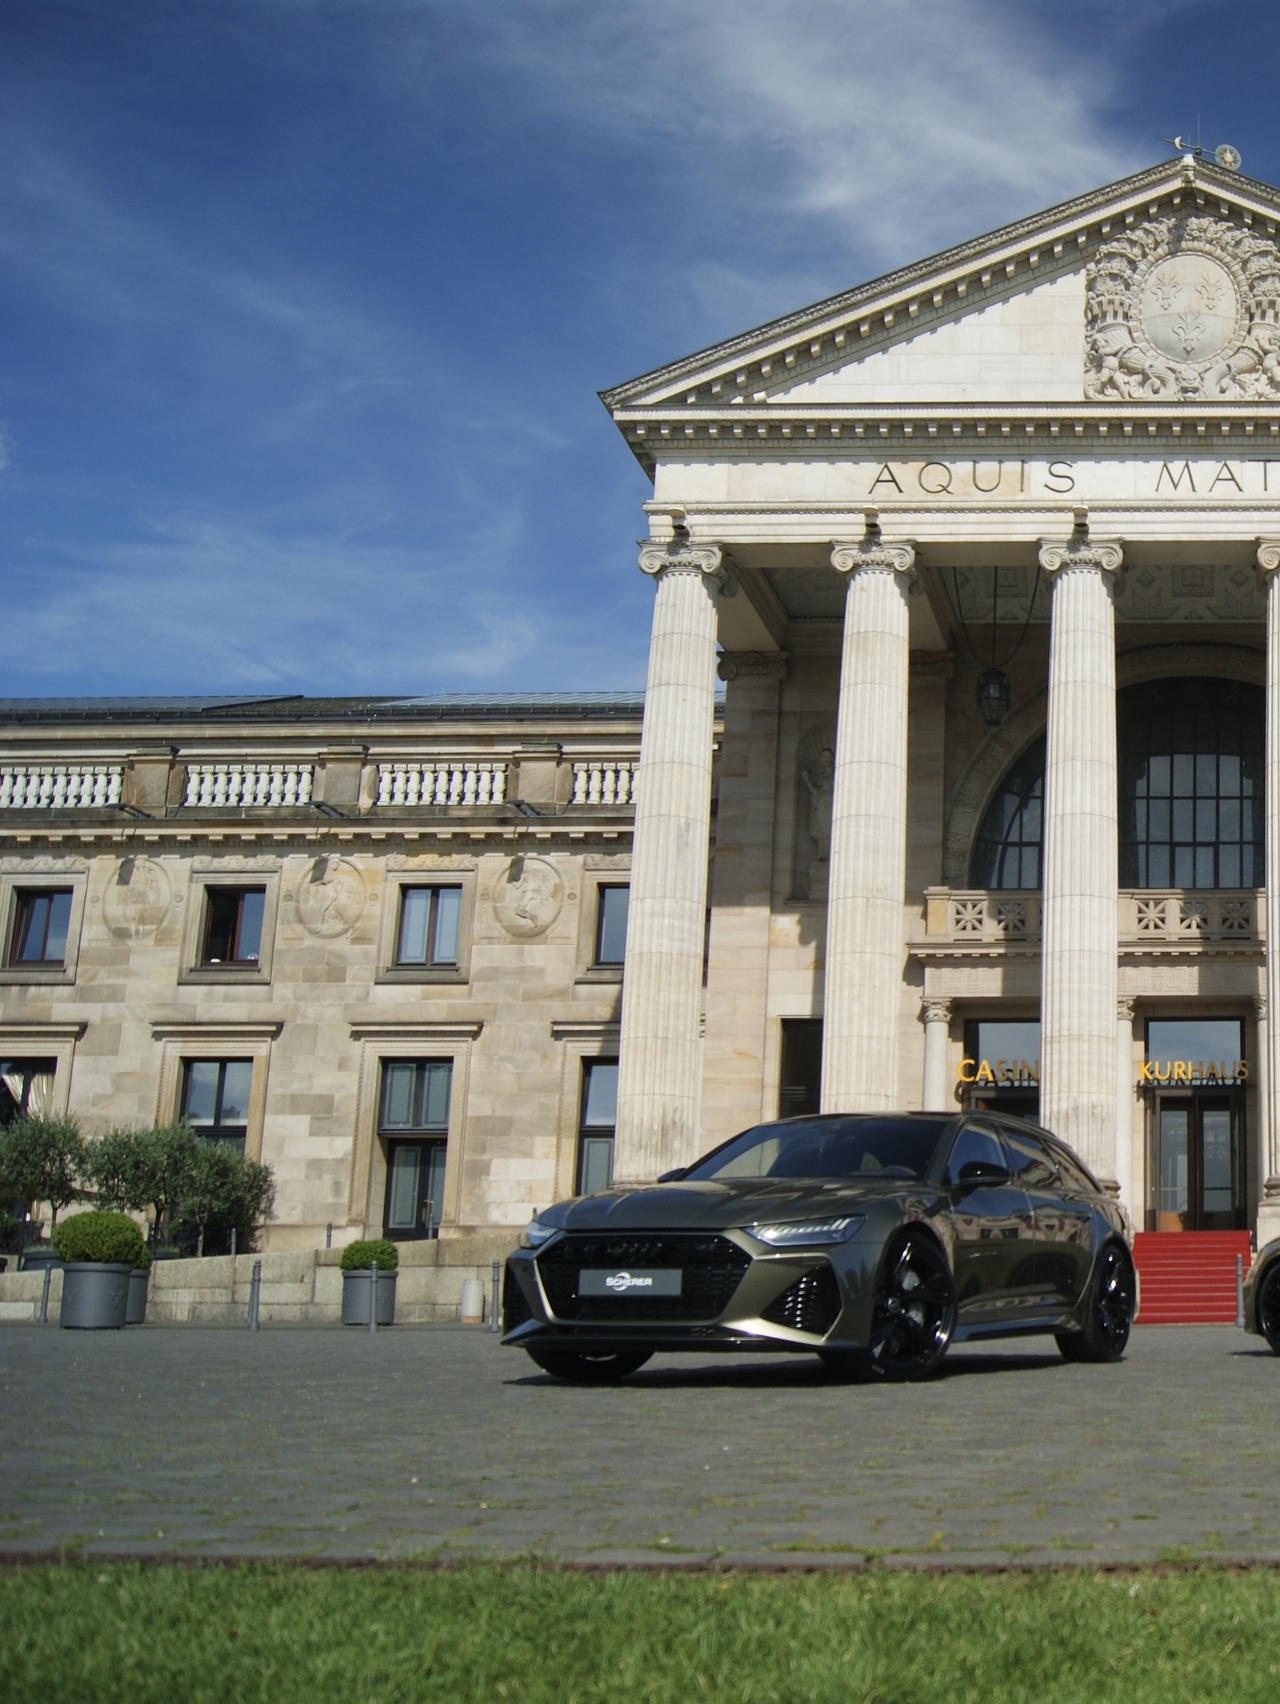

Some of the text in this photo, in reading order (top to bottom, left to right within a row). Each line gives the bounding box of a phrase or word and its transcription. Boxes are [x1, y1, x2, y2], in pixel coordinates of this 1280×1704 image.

[868, 460, 1075, 494] AQUIS
[956, 1058, 1040, 1082] CASIN
[1140, 1060, 1249, 1080] KURHAUS
[605, 1275, 653, 1287] SCHERER
